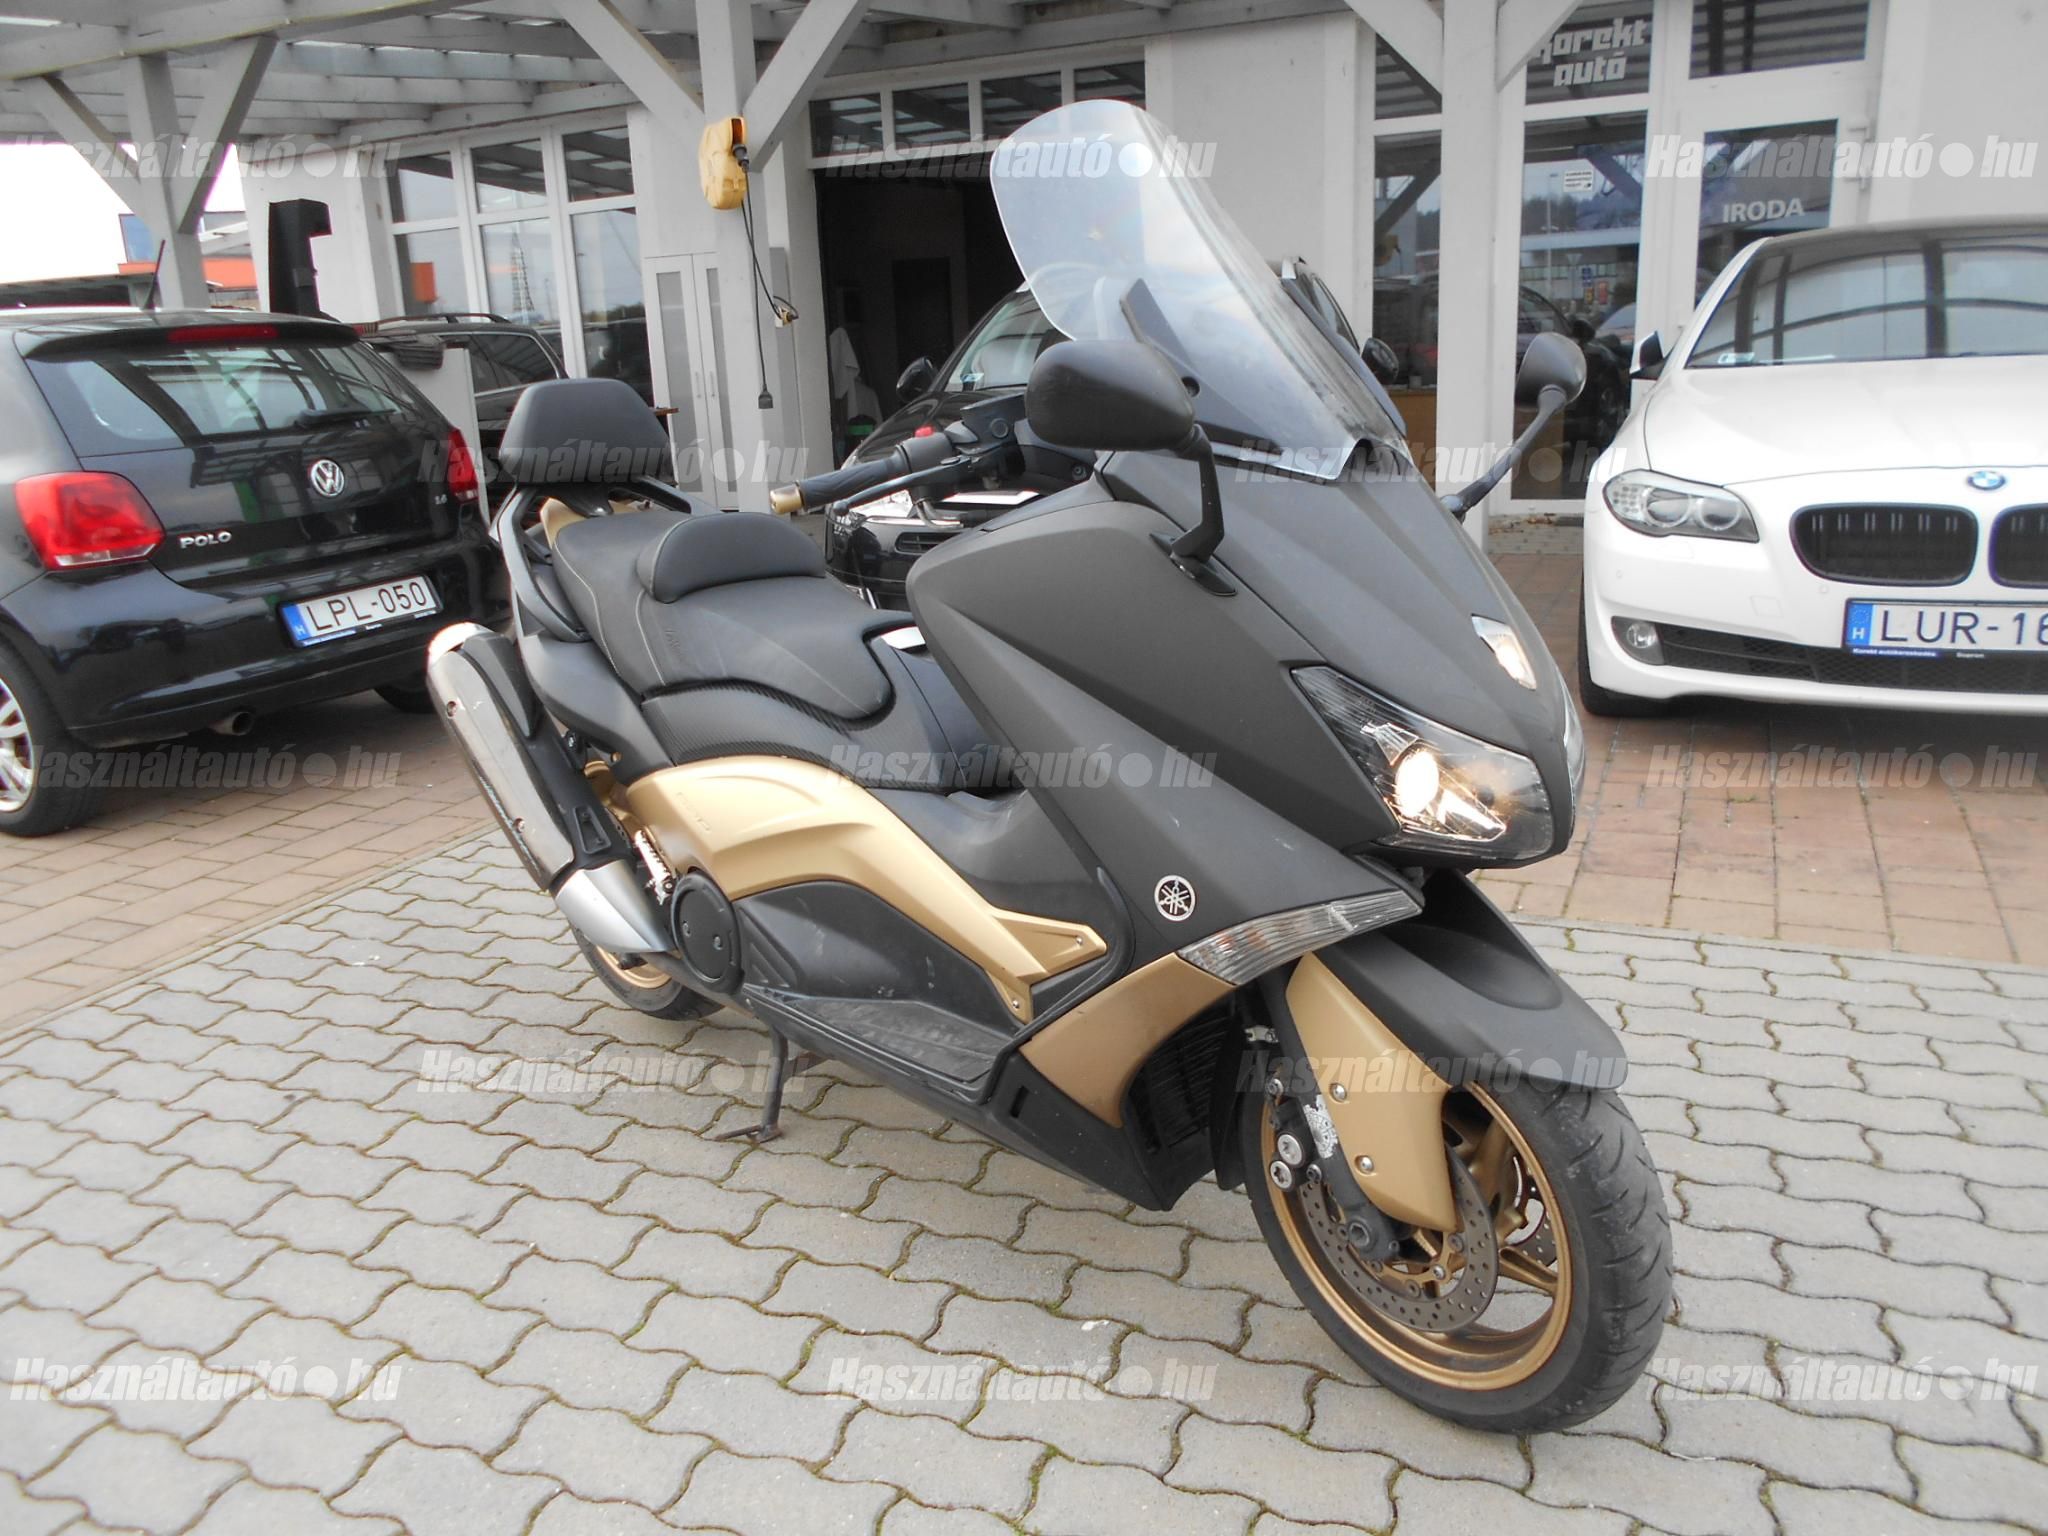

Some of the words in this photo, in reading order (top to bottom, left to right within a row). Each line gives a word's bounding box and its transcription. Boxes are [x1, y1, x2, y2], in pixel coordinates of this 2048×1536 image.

[1553, 51, 1628, 87] autó
[1723, 198, 1805, 223] IRODA
[180, 530, 232, 549] POLO
[306, 581, 428, 630] LPL-050
